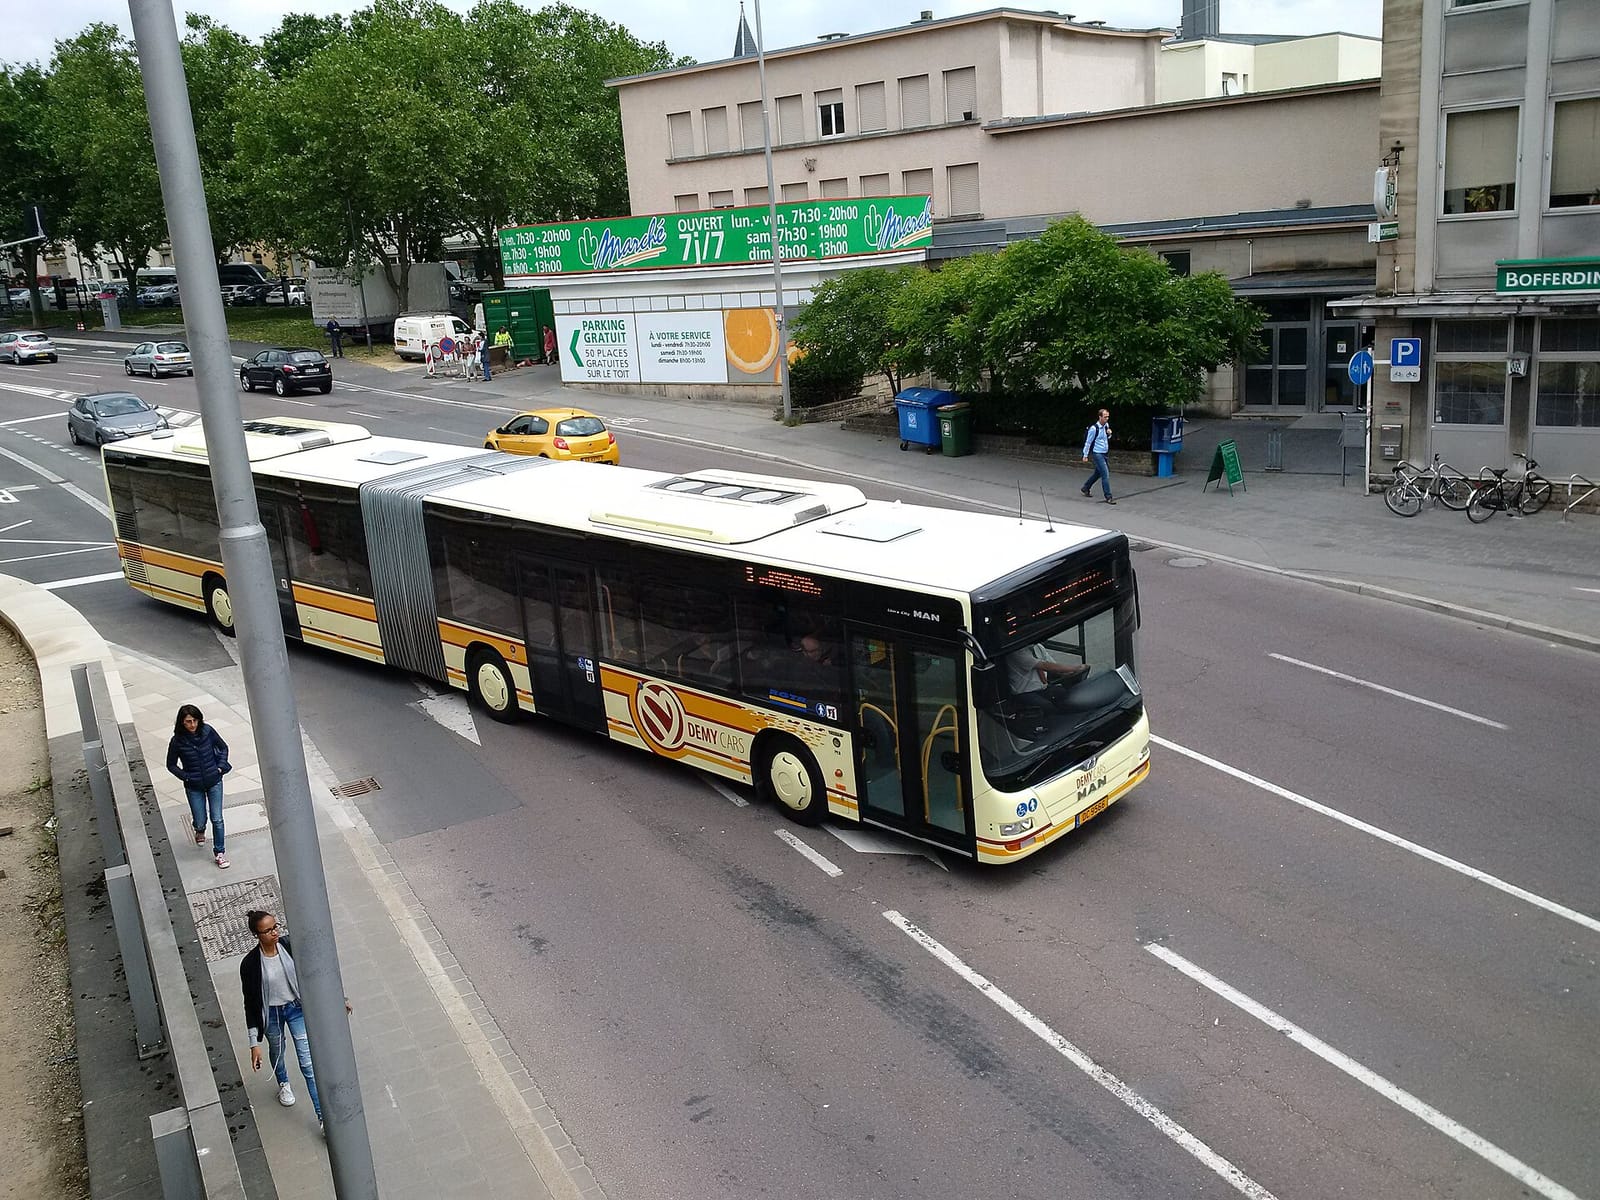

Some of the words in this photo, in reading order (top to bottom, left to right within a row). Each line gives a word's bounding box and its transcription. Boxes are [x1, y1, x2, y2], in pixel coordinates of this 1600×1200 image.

[677, 215, 725, 233] OUVERT
[762, 213, 789, 227] vn.
[791, 207, 820, 224] 7h30
[829, 205, 858, 221] 20h00
[516, 231, 535, 246] 7h30
[541, 228, 571, 244] 20h00
[777, 226, 808, 242] 7h30
[819, 223, 848, 239] 19h00
[511, 247, 527, 260] 7h30
[533, 244, 562, 259] 19h00
[594, 216, 667, 270] Marché
[678, 231, 725, 265] 7j/7
[778, 243, 808, 259] 8h00
[819, 240, 848, 257] 13h00
[534, 259, 563, 274] 13h00
[582, 319, 626, 331] PARKING
[583, 332, 627, 344] GRATUIT
[656, 331, 680, 341] VOTRE
[680, 331, 712, 340] SERVICE
[585, 348, 595, 358] 50
[597, 348, 629, 358] PLACES
[1397, 342, 1414, 364] P
[586, 359, 629, 368] GRATUITES
[587, 369, 602, 378] SUR
[602, 369, 612, 378] LE
[612, 369, 630, 378] TOIT
[913, 609, 940, 623] MAN
[687, 721, 718, 745] DEMY
[719, 731, 745, 754] CARS
[1076, 769, 1093, 790] DEMY
[1077, 775, 1107, 801] MAN
